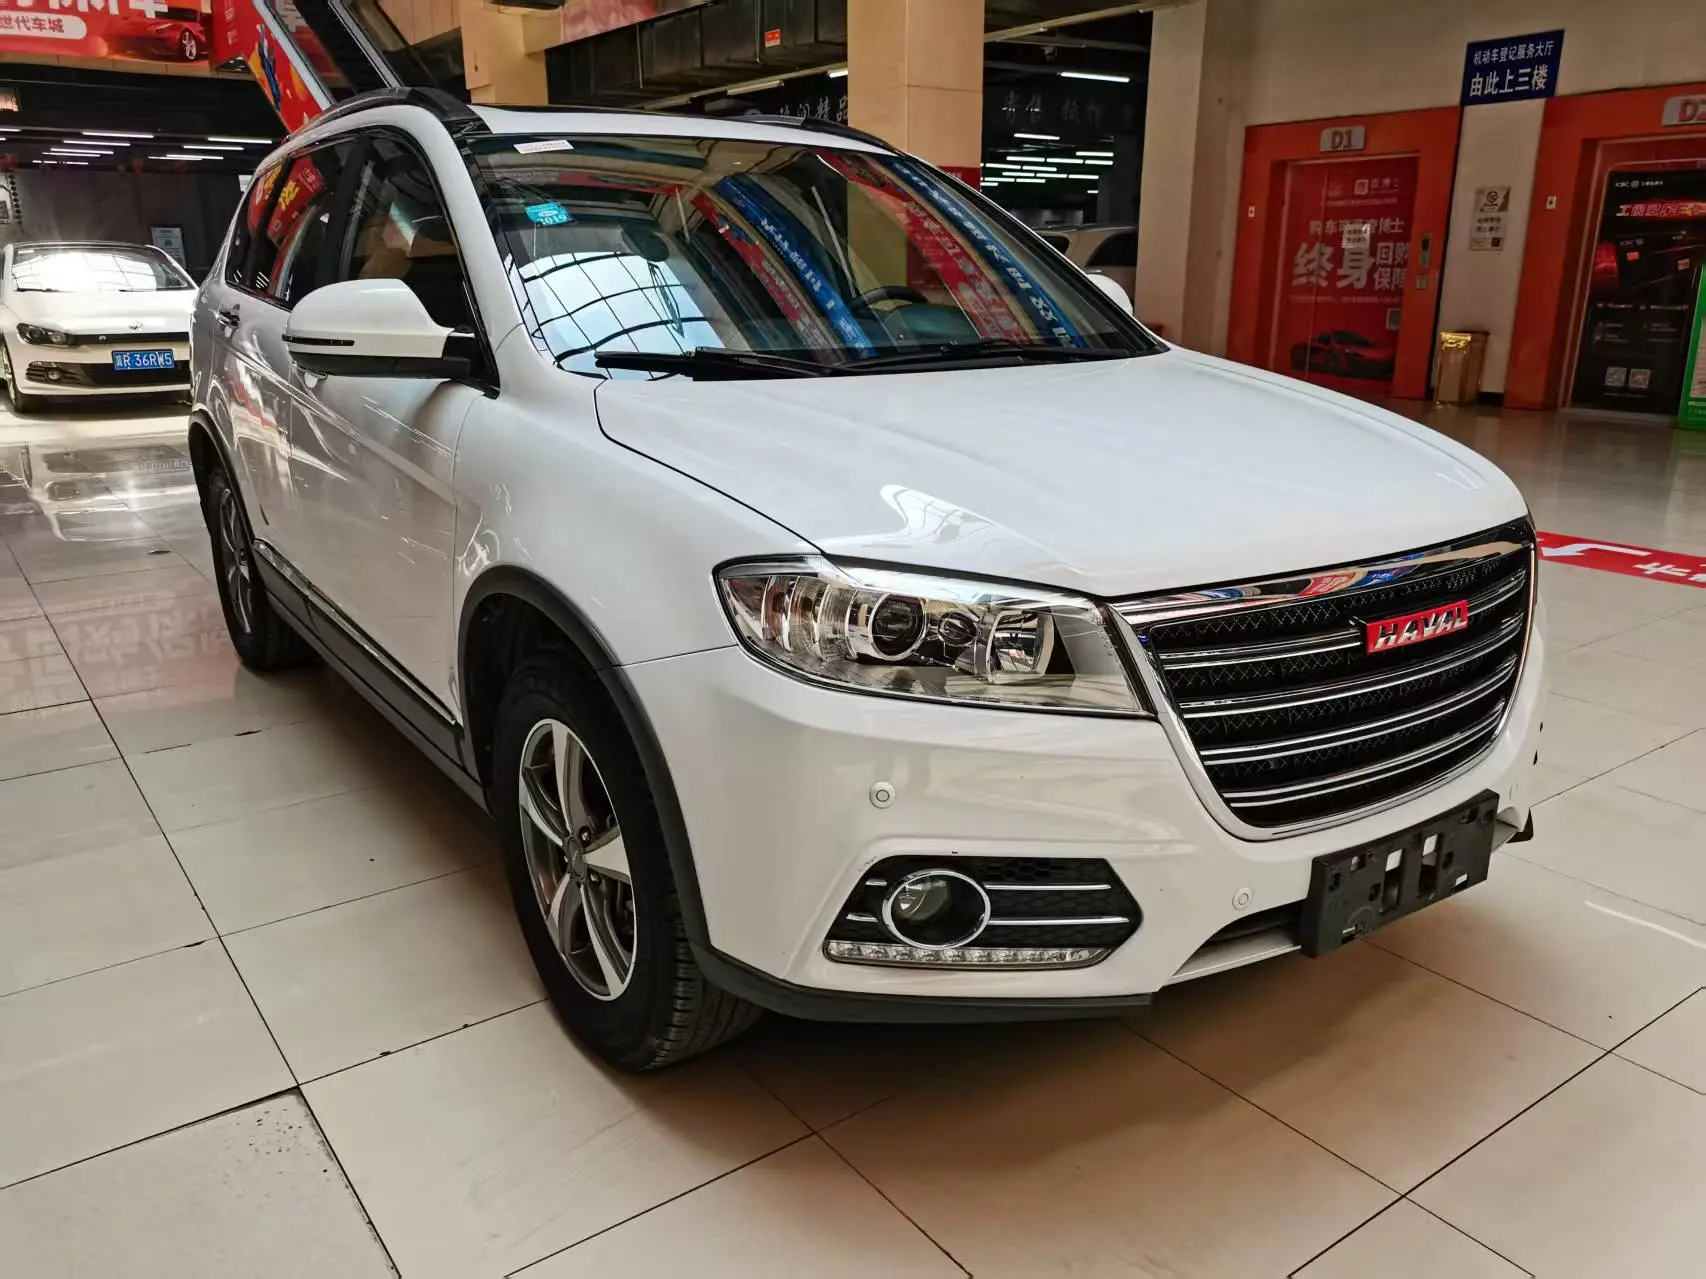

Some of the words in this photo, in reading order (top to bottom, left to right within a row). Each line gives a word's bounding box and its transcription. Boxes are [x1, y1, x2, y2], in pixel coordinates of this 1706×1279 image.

[1473, 41, 1554, 65] 机动车登记服务大厅
[1469, 63, 1548, 97] 由此上三楼
[1330, 130, 1353, 149] D1
[1374, 607, 1468, 649] HAVAL
